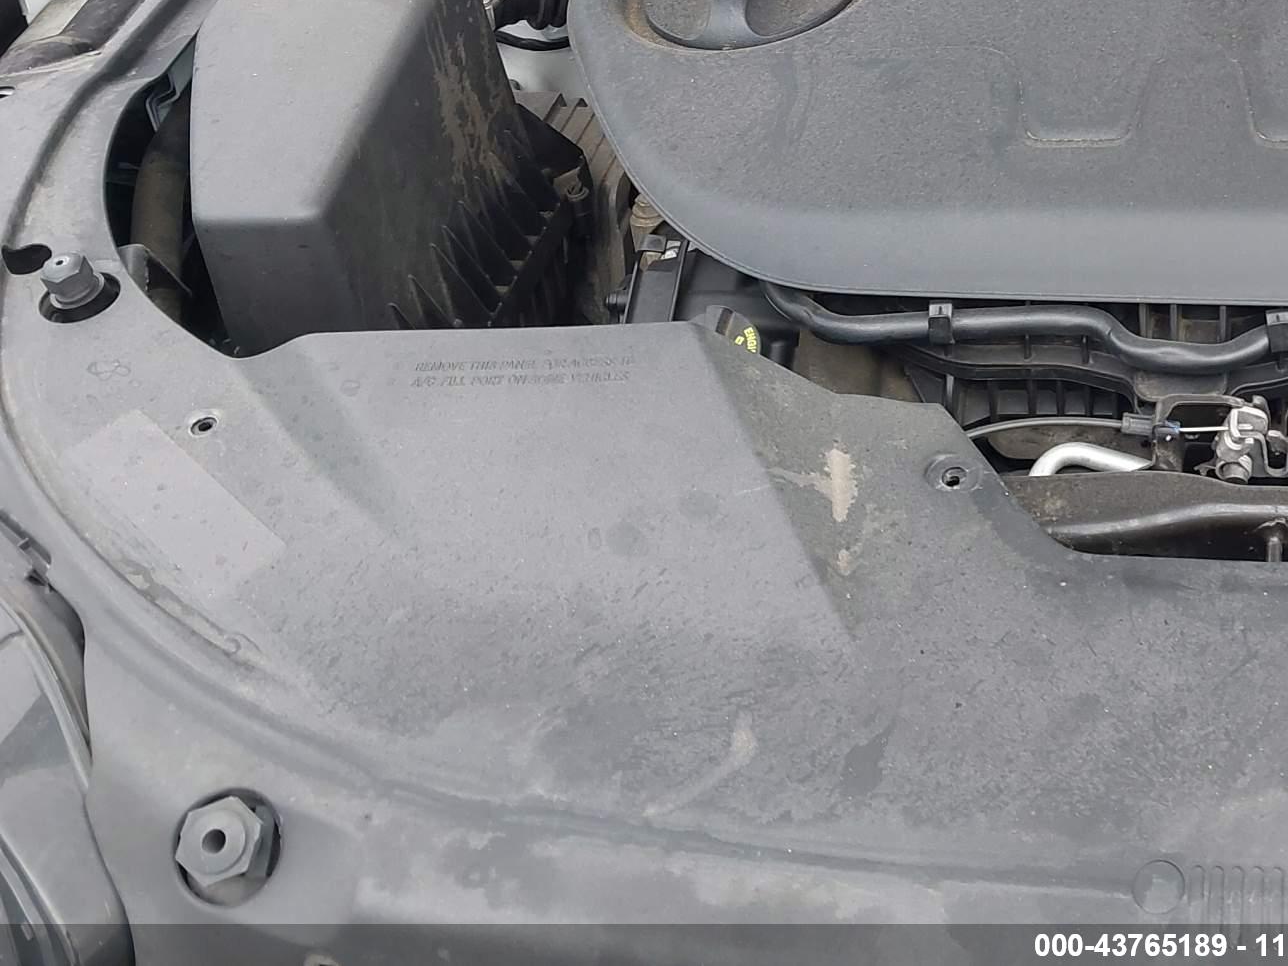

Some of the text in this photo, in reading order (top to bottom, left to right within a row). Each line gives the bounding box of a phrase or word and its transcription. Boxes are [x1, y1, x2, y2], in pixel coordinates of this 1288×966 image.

[414, 360, 466, 372] REMOVE
[470, 360, 497, 371] THIS
[499, 358, 537, 371] PANEL
[440, 375, 466, 387] FILL
[470, 374, 505, 386] PORT
